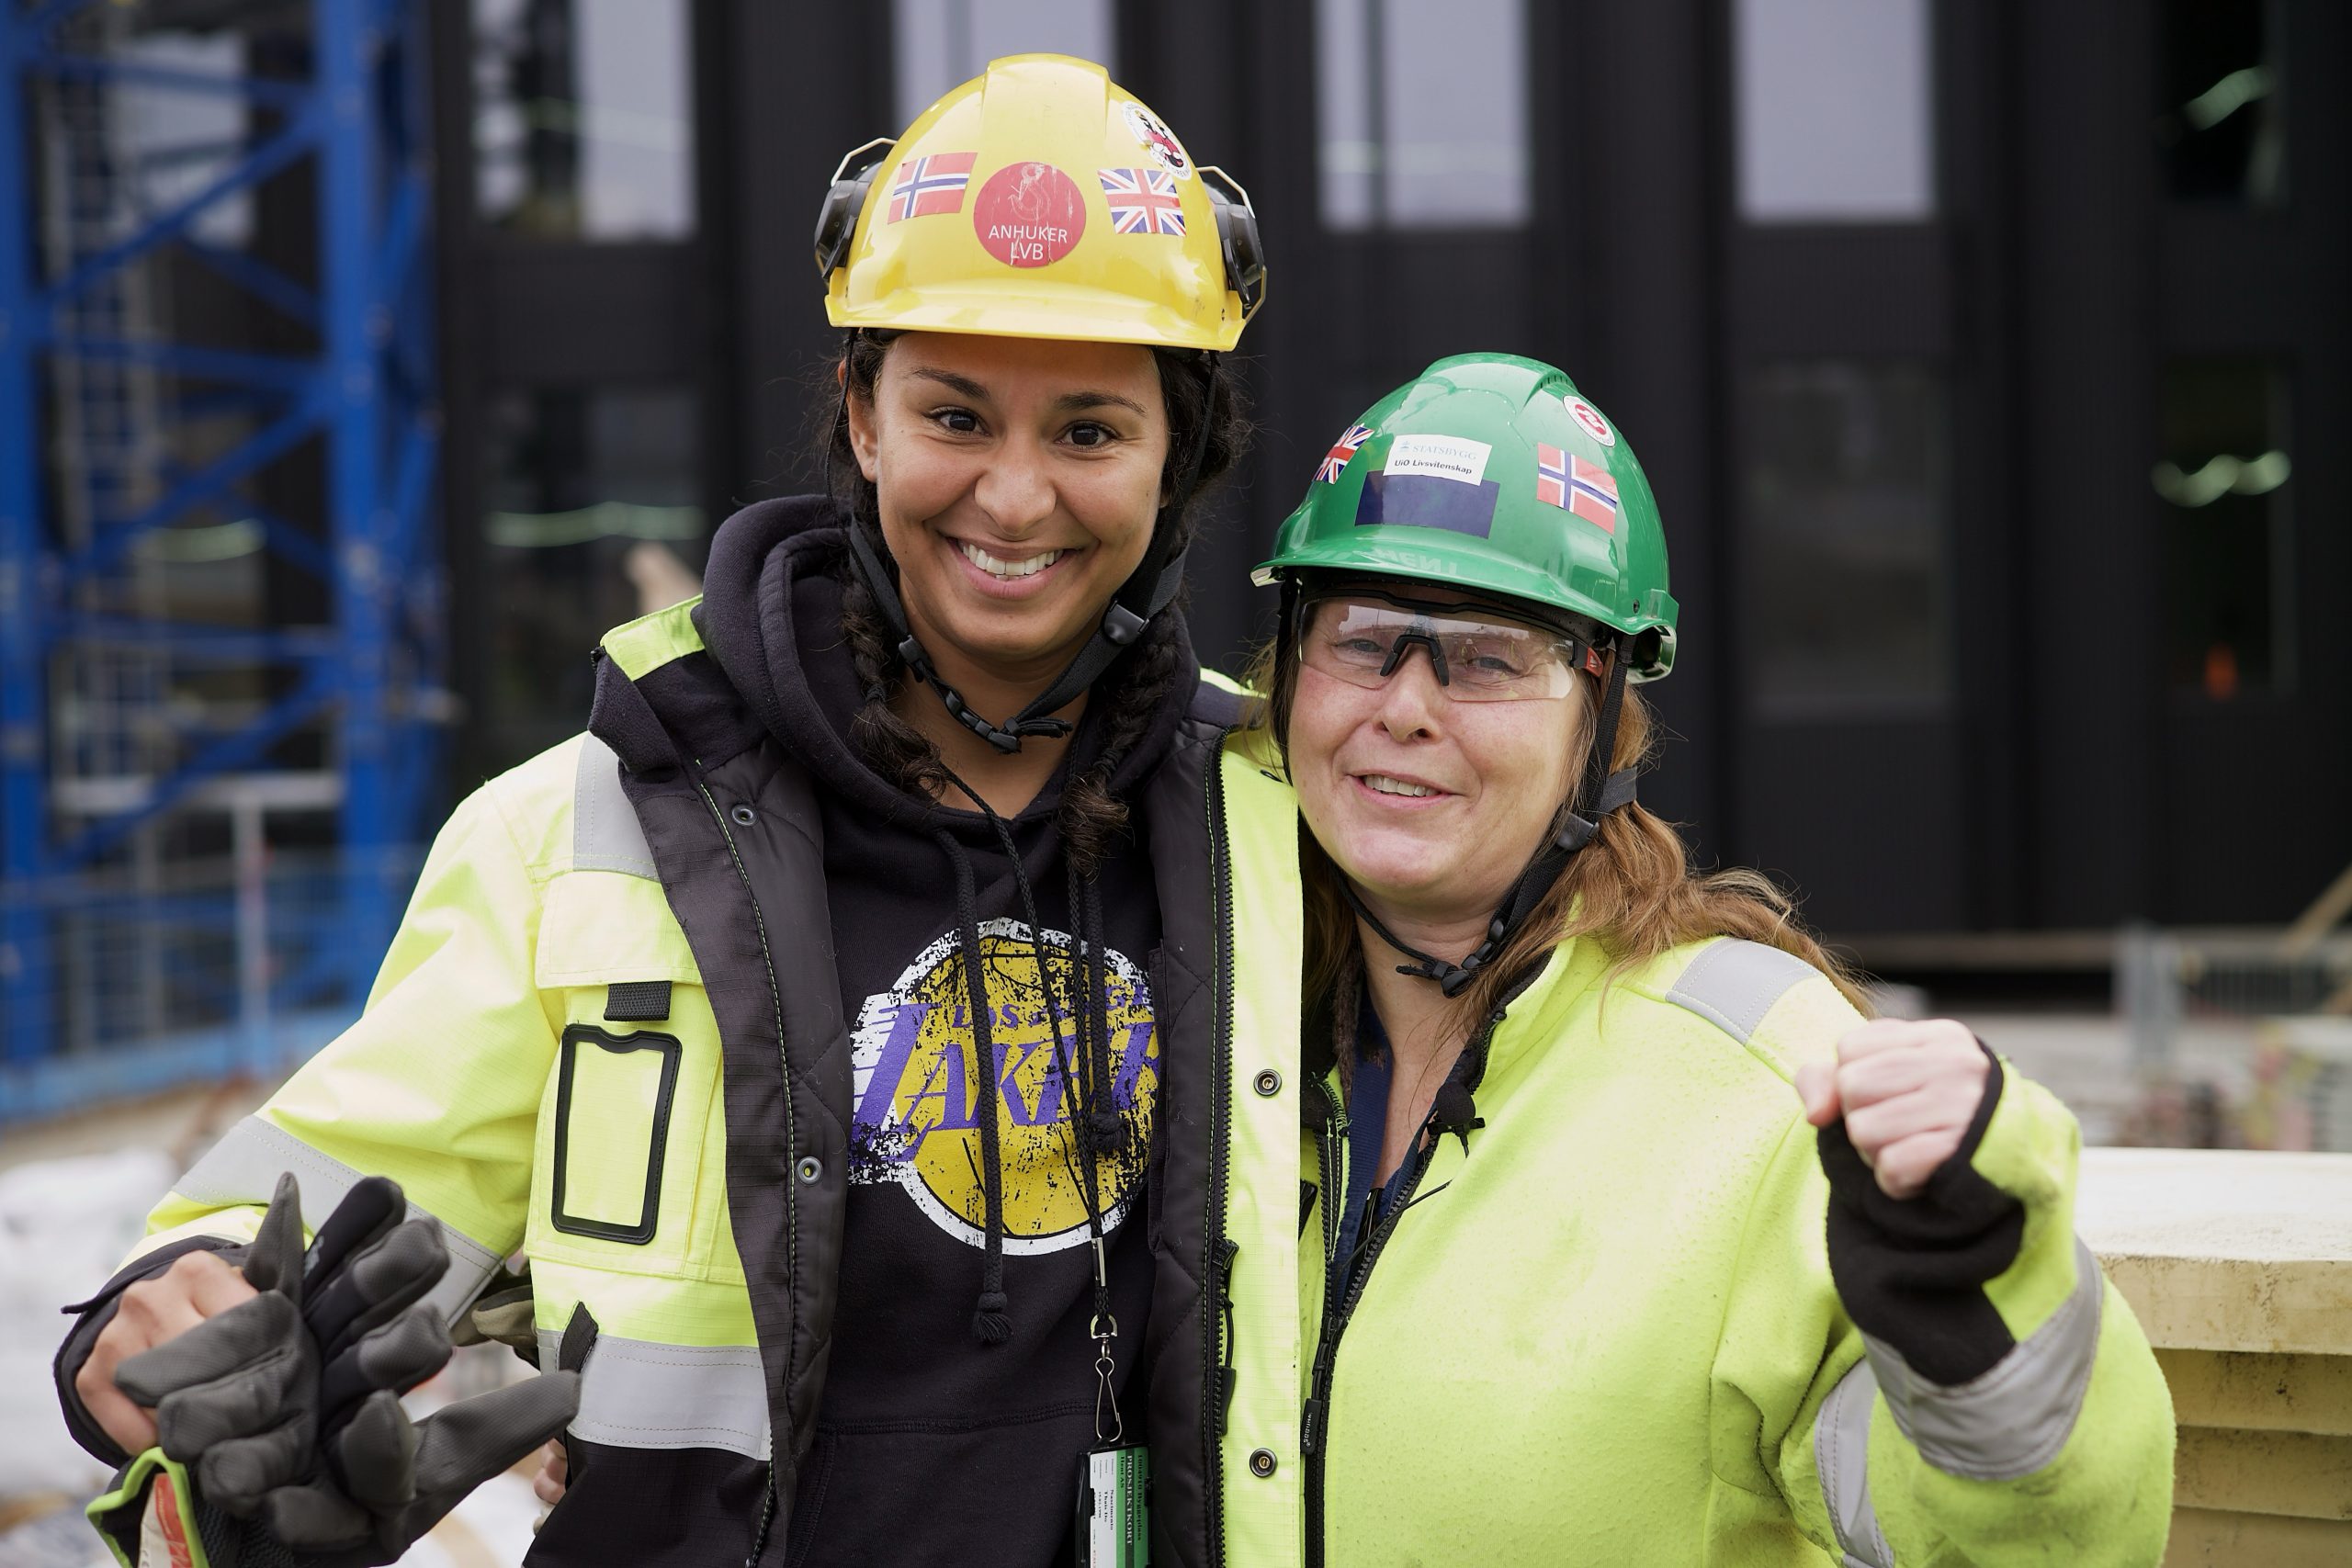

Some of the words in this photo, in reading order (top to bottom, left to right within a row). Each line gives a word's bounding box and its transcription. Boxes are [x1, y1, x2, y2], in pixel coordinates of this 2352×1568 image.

[989, 225, 1068, 243] ANHUKER
[1011, 242, 1044, 261] LVB
[1412, 445, 1476, 460] STATSBYGG
[1394, 459, 1410, 468] UiO
[1412, 458, 1473, 475] Livsvitenskap
